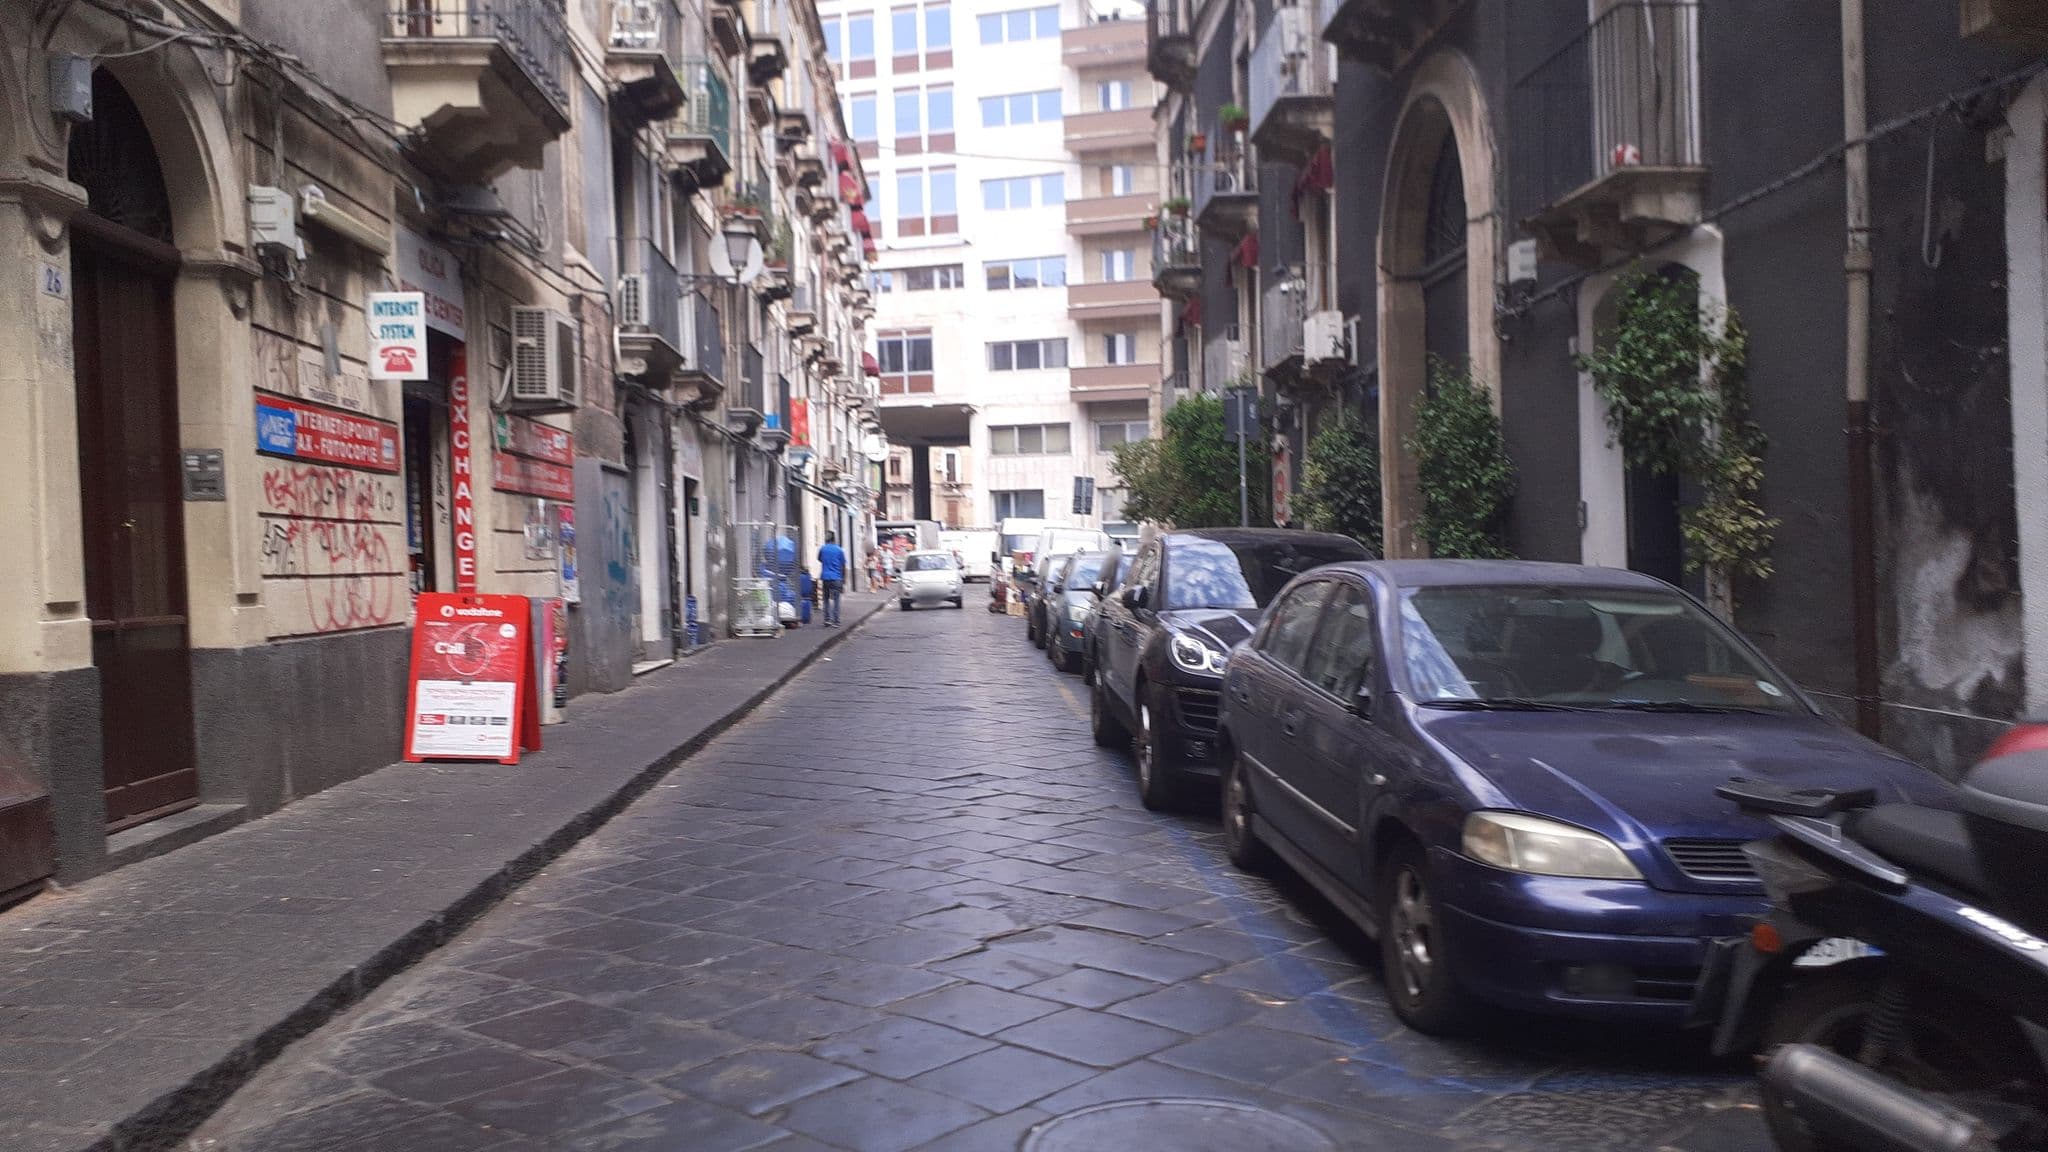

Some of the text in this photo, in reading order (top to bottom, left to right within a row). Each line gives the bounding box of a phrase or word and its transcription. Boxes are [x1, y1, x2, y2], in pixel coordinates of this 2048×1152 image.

[46, 267, 62, 293] 26
[373, 301, 419, 317] INTERNET
[379, 323, 416, 340] SYSTEM
